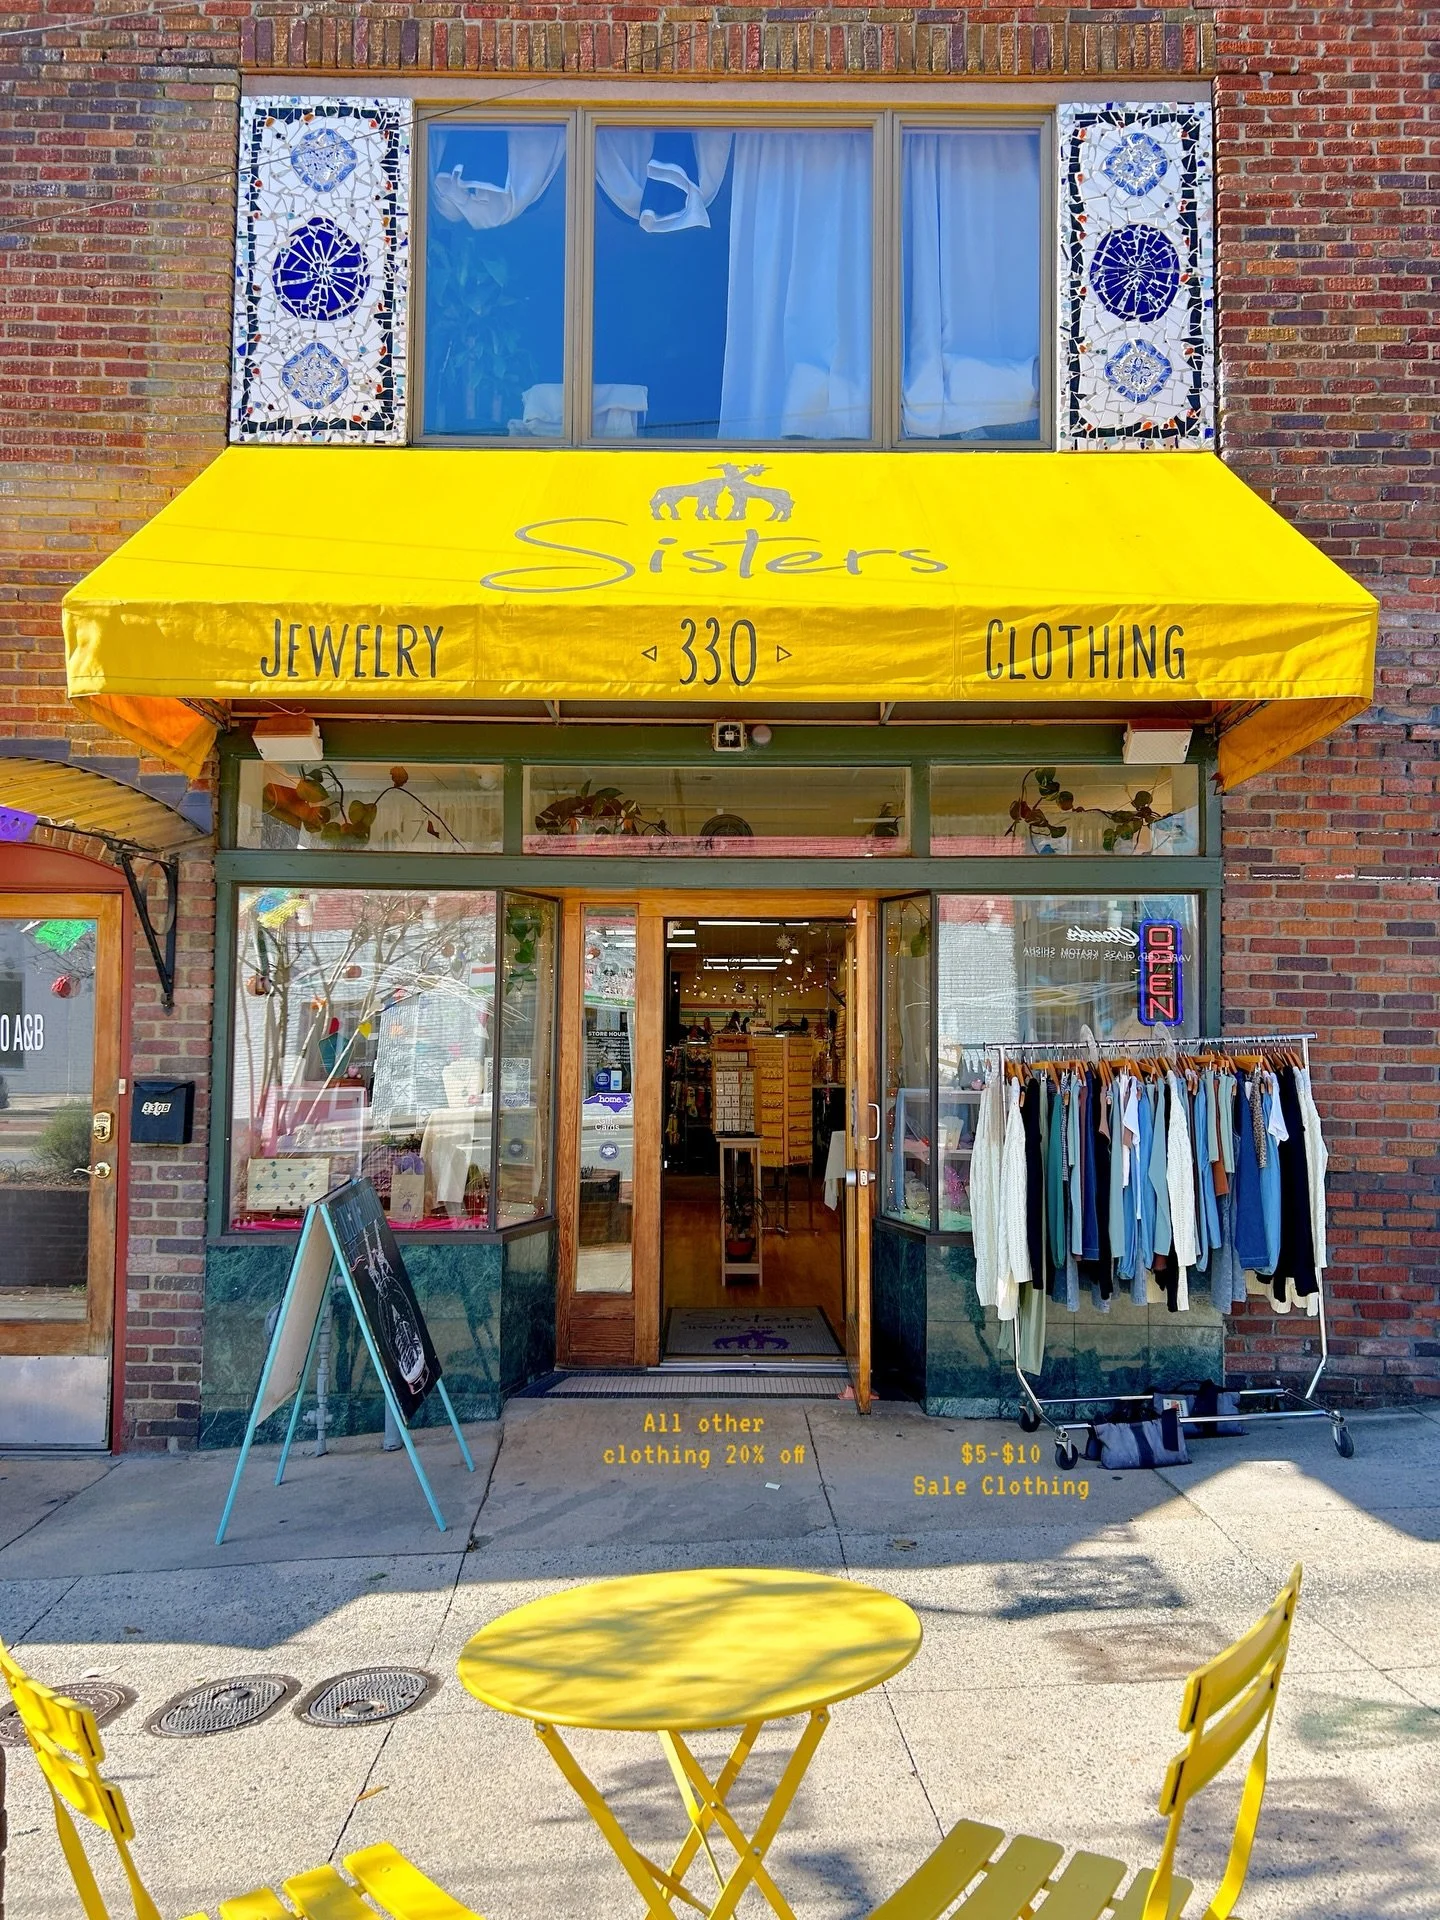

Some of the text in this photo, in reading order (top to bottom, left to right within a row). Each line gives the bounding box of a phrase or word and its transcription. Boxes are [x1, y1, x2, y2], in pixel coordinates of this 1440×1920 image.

[480, 518, 948, 593] Sisters
[260, 618, 445, 679] JEWELRY
[679, 617, 757, 687] 330
[985, 619, 1187, 680] CLOTHING
[1147, 927, 1174, 1019] OPEN
[13, 1014, 44, 1051] A&B
[142, 1102, 171, 1115] 330B
[595, 1123, 620, 1131] Cards
